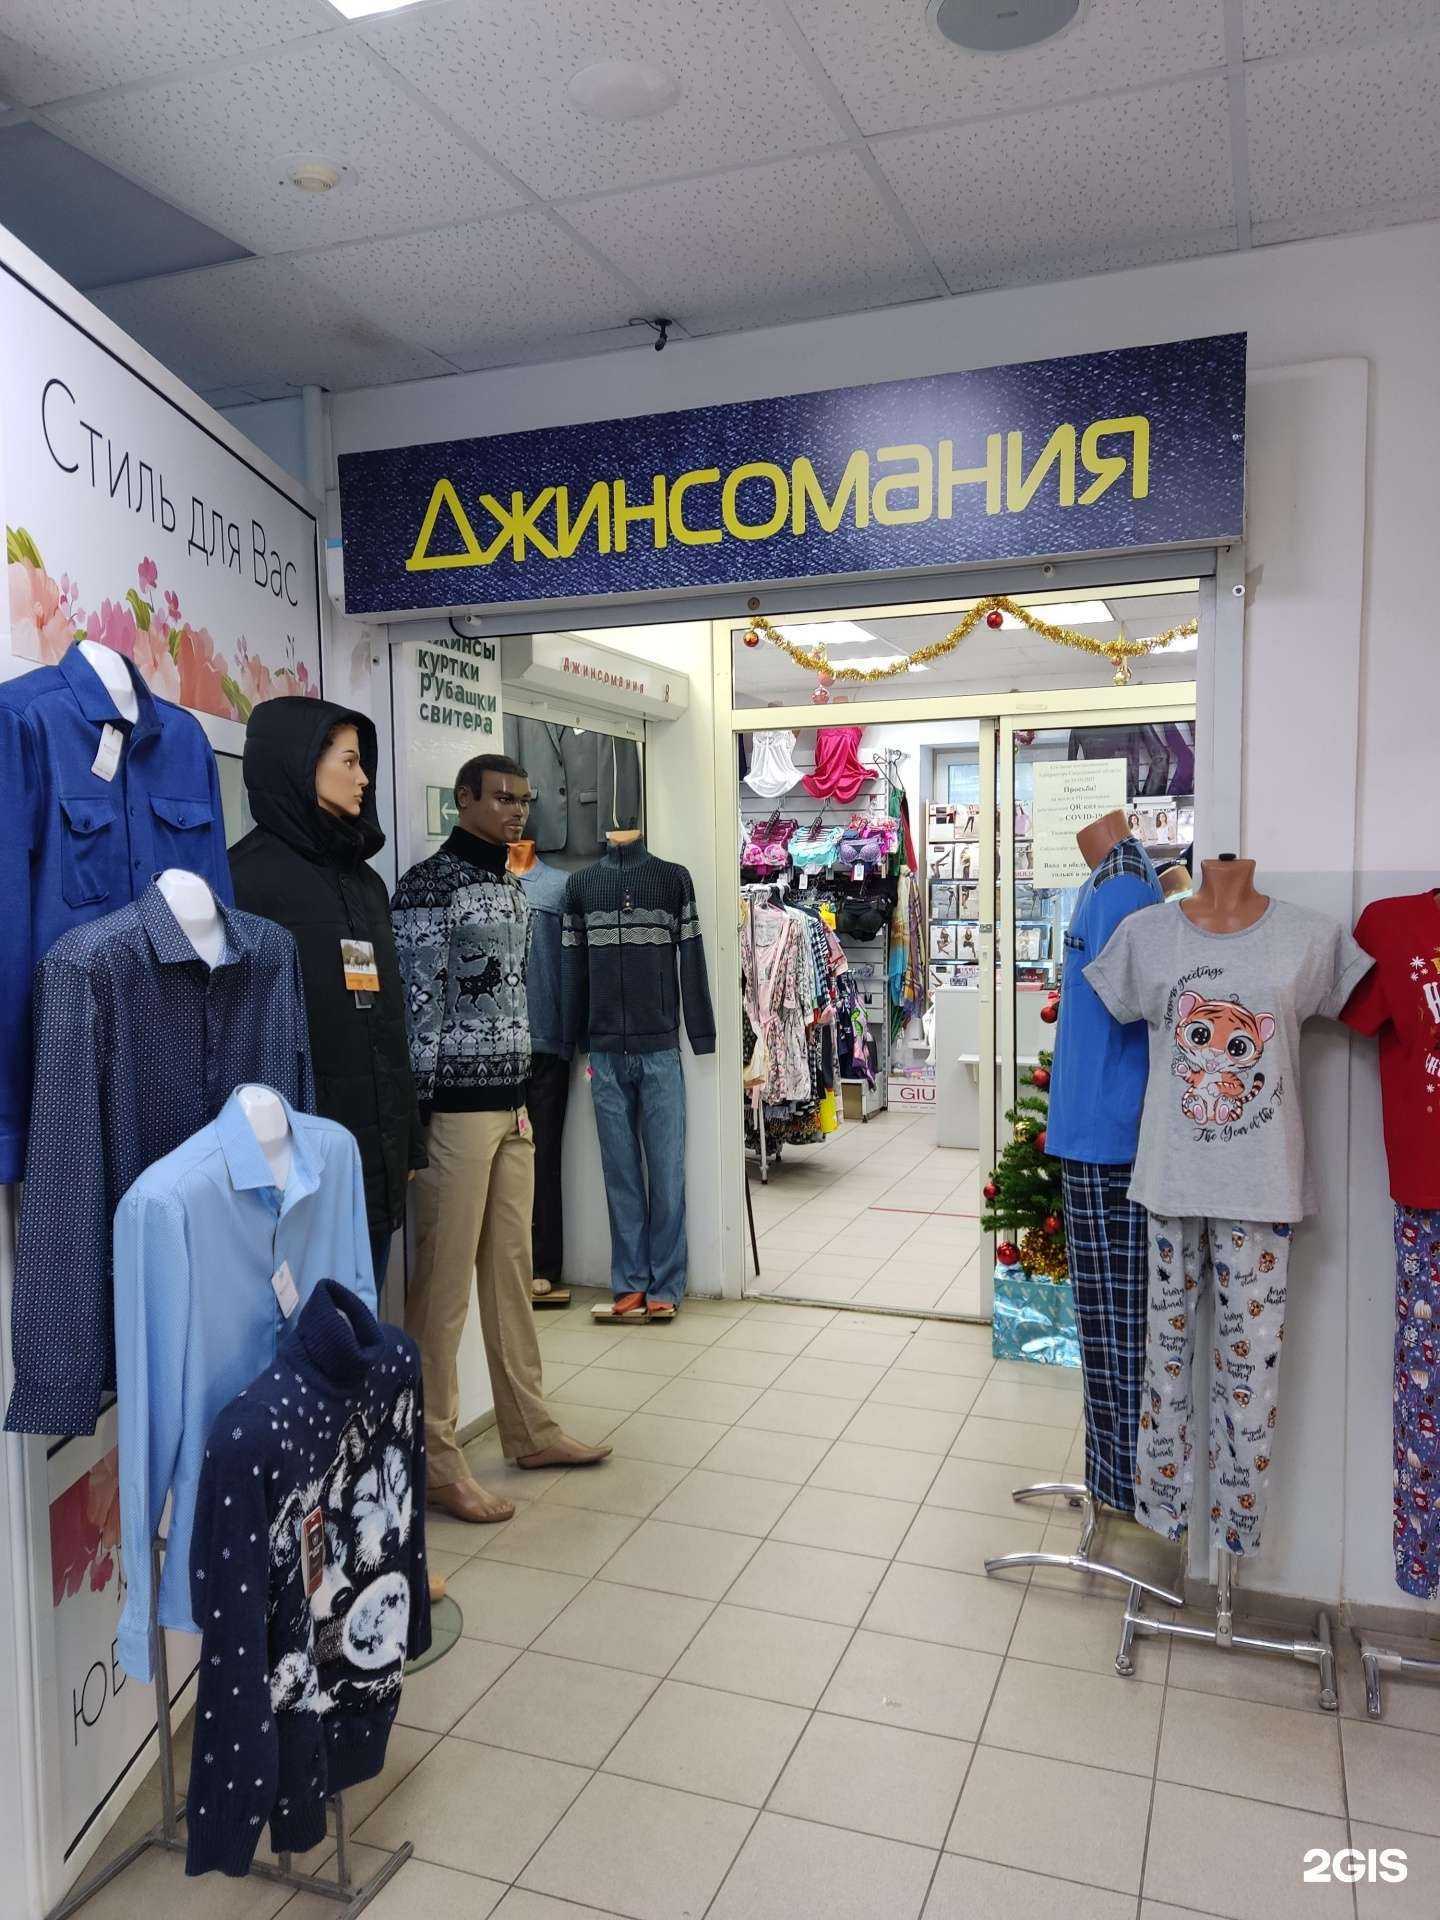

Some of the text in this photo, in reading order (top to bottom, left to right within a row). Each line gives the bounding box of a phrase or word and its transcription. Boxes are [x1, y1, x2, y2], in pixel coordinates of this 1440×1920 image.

[42, 378, 299, 608] Стиль для Вас
[418, 648, 480, 682] куртки
[420, 671, 497, 713] рубашки
[419, 702, 493, 735] свитера
[1177, 965, 1224, 991] greetings
[1191, 1127, 1217, 1143] The
[1220, 1124, 1248, 1142] Year
